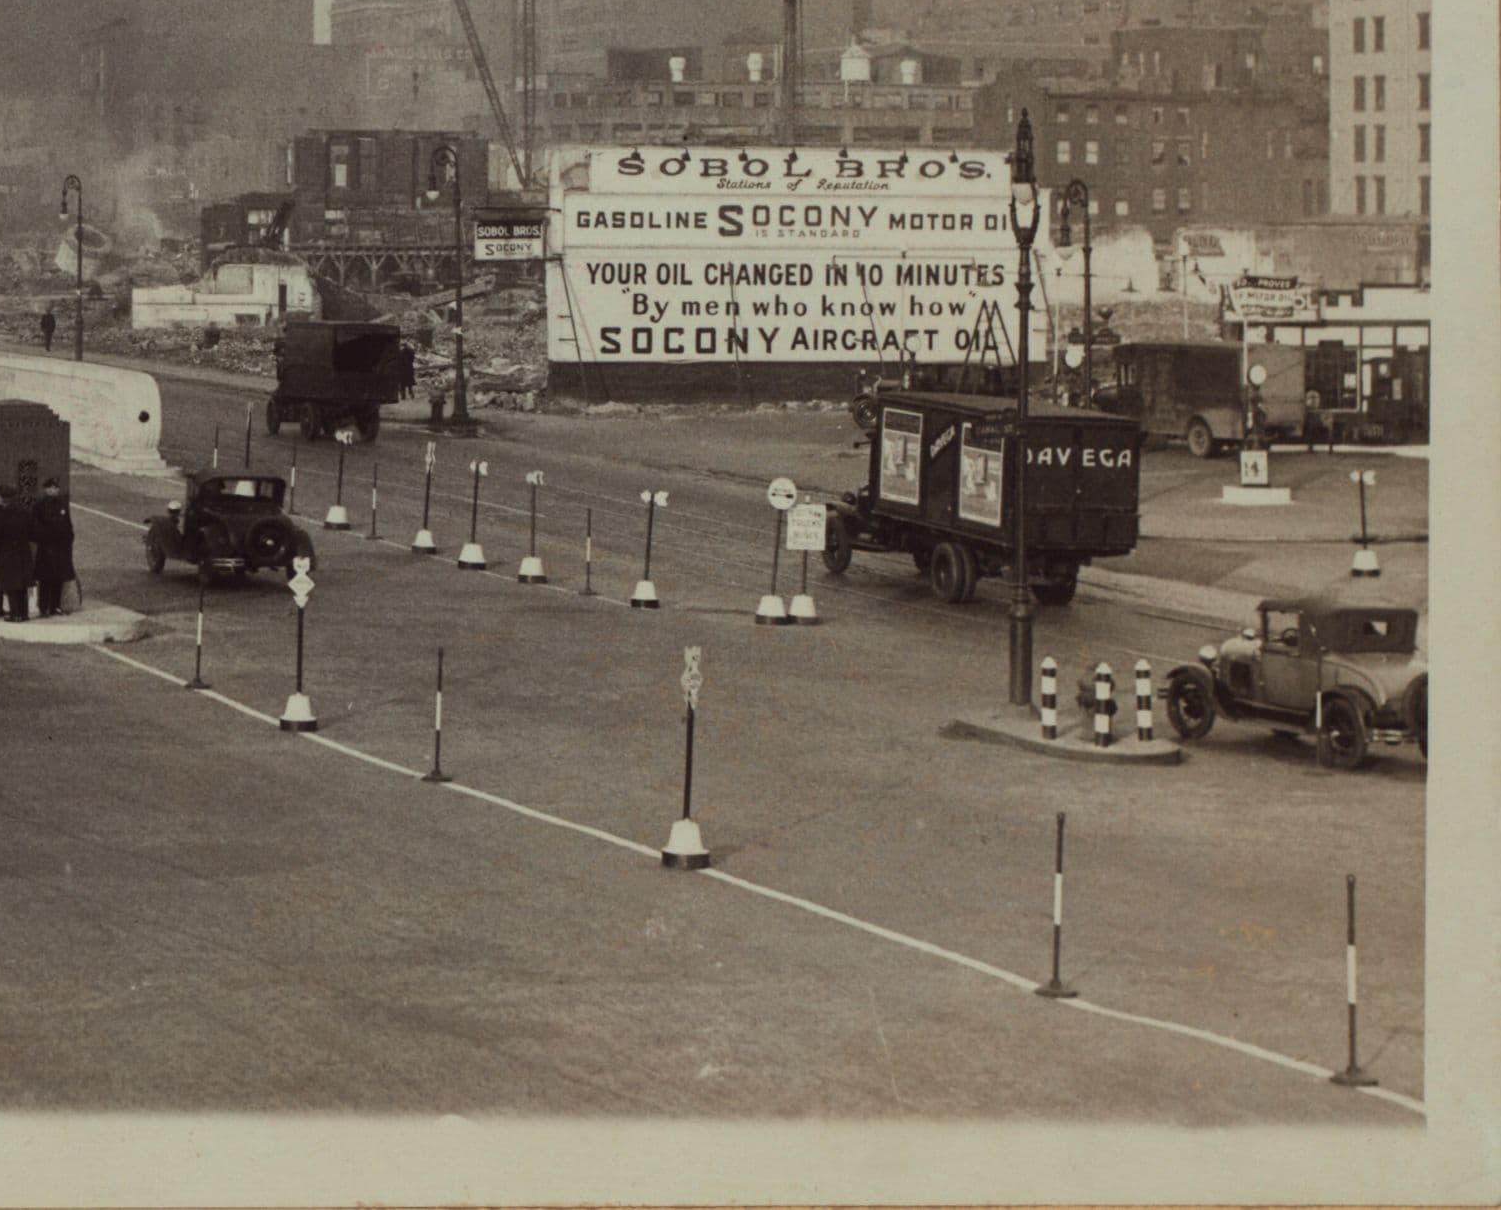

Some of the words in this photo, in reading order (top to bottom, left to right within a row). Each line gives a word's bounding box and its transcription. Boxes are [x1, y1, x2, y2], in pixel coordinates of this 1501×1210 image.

[617, 157, 812, 178] SOBOL
[716, 177, 771, 190] Stations
[787, 179, 803, 191] of
[816, 177, 890, 190] Reputation
[576, 210, 708, 229] GASOLINE
[718, 204, 878, 237] SOCONY
[889, 213, 973, 231] MOTOR
[477, 225, 510, 238] SOBOL
[755, 229, 768, 238] IS
[777, 230, 860, 238] STANDARD
[485, 243, 532, 256] SOCONY
[586, 262, 647, 286] YOUR
[656, 262, 693, 286] OIL
[704, 263, 813, 286] CHANGED
[825, 264, 848, 287] IN
[859, 263, 884, 287] 10
[896, 264, 1005, 287] MINUTES
[681, 300, 740, 316] men
[752, 294, 808, 316] who
[821, 294, 896, 317] know
[600, 326, 780, 354] SOCONY
[954, 328, 999, 352] OIL
